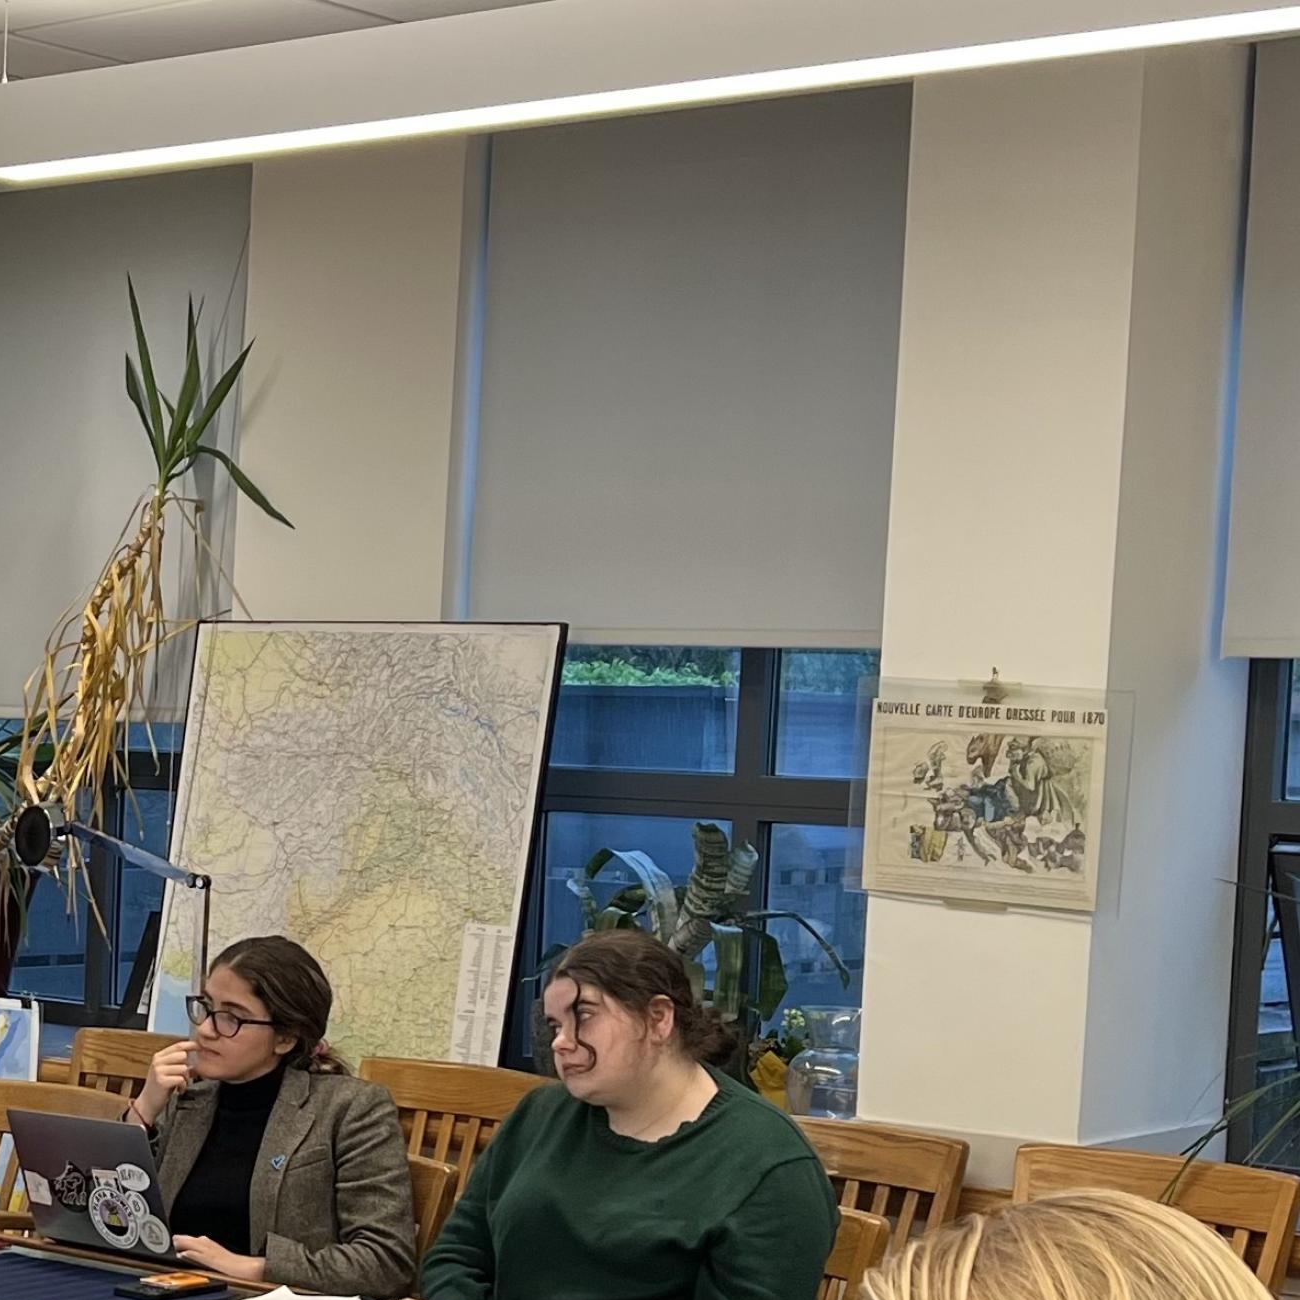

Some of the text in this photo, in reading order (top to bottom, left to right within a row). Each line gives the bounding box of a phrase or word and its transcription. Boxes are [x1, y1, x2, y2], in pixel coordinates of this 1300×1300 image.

[877, 702, 921, 716] NOUVELLE
[925, 703, 954, 717] CARTE
[958, 705, 1001, 720] D'EUROPE
[1051, 709, 1076, 724] POUR
[1082, 711, 1105, 725] 1870
